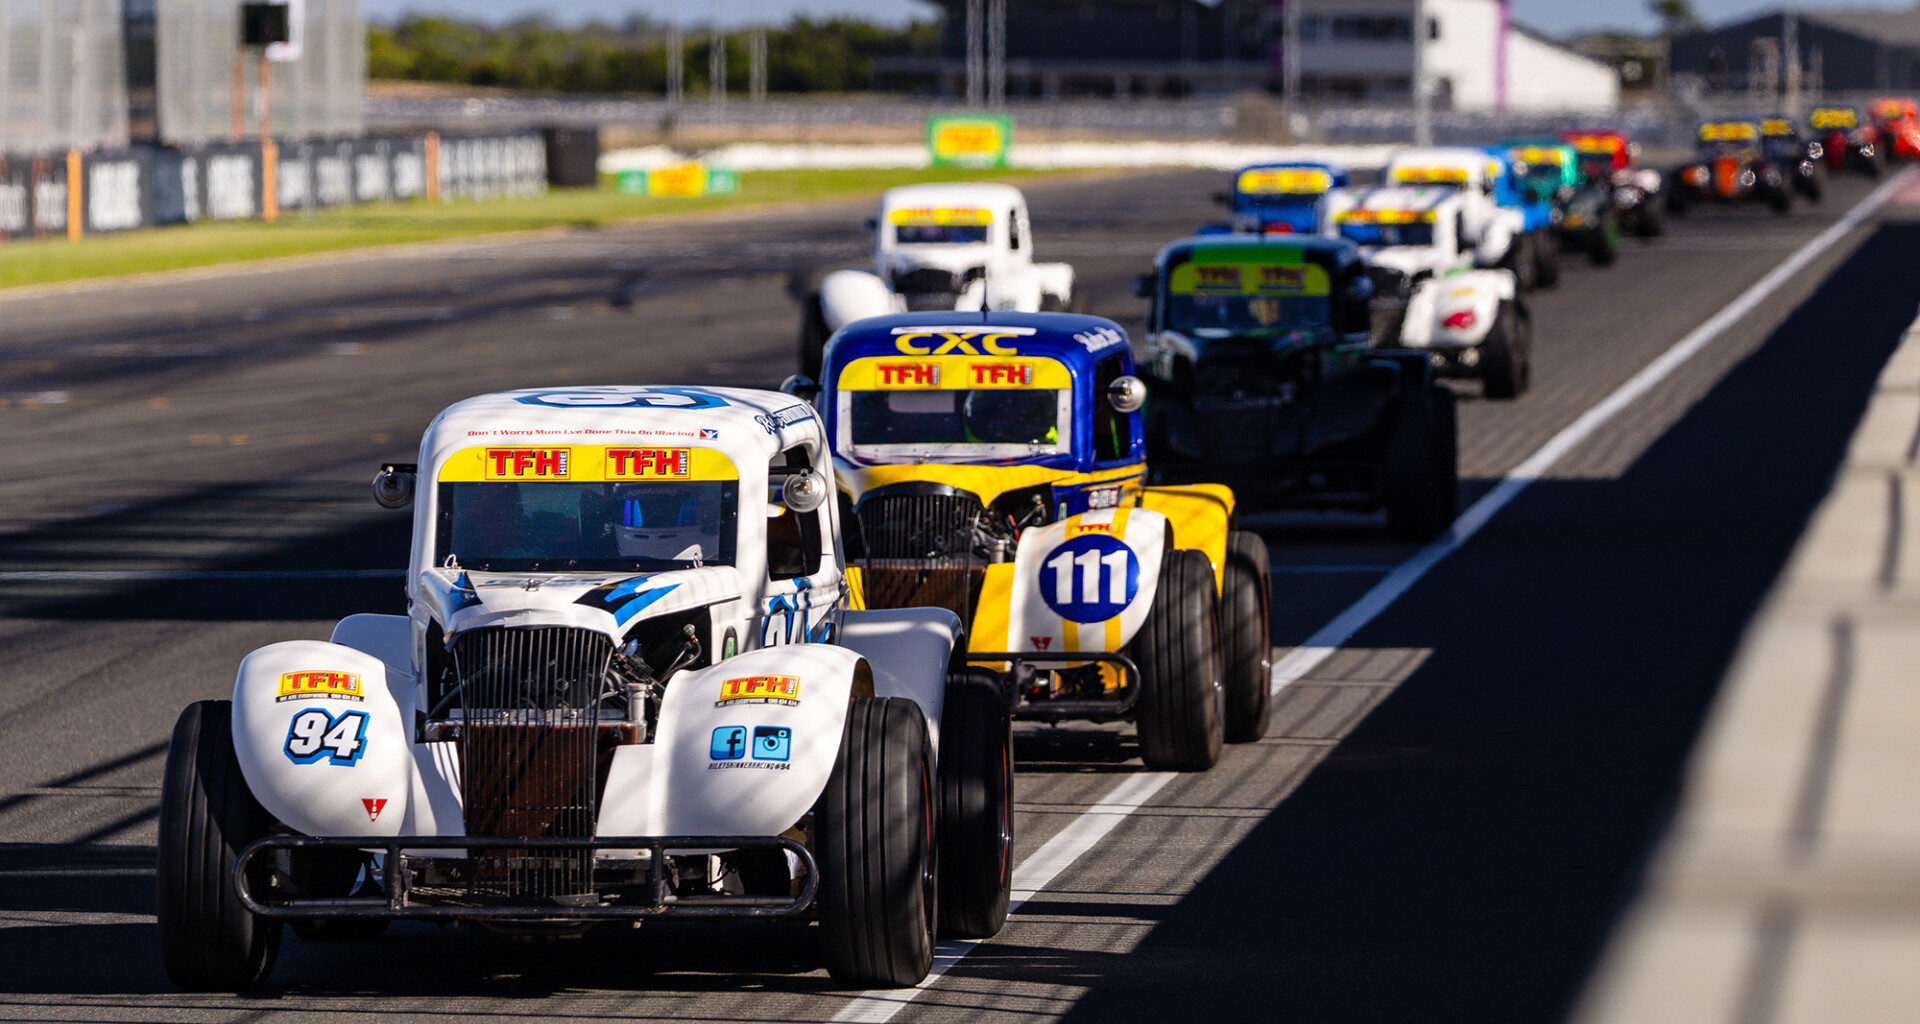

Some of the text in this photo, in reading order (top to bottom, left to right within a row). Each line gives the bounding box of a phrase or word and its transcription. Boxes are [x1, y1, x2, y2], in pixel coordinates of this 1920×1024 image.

[895, 333, 1018, 356] CXC
[879, 364, 932, 384] TFH
[971, 364, 1025, 384] TFH
[489, 450, 567, 475] TFH HIRE
[608, 450, 687, 475] TFH HIRE
[1047, 549, 1128, 604] 111
[286, 672, 350, 689] TFH
[726, 676, 789, 694] TFH
[285, 710, 366, 761] 94
